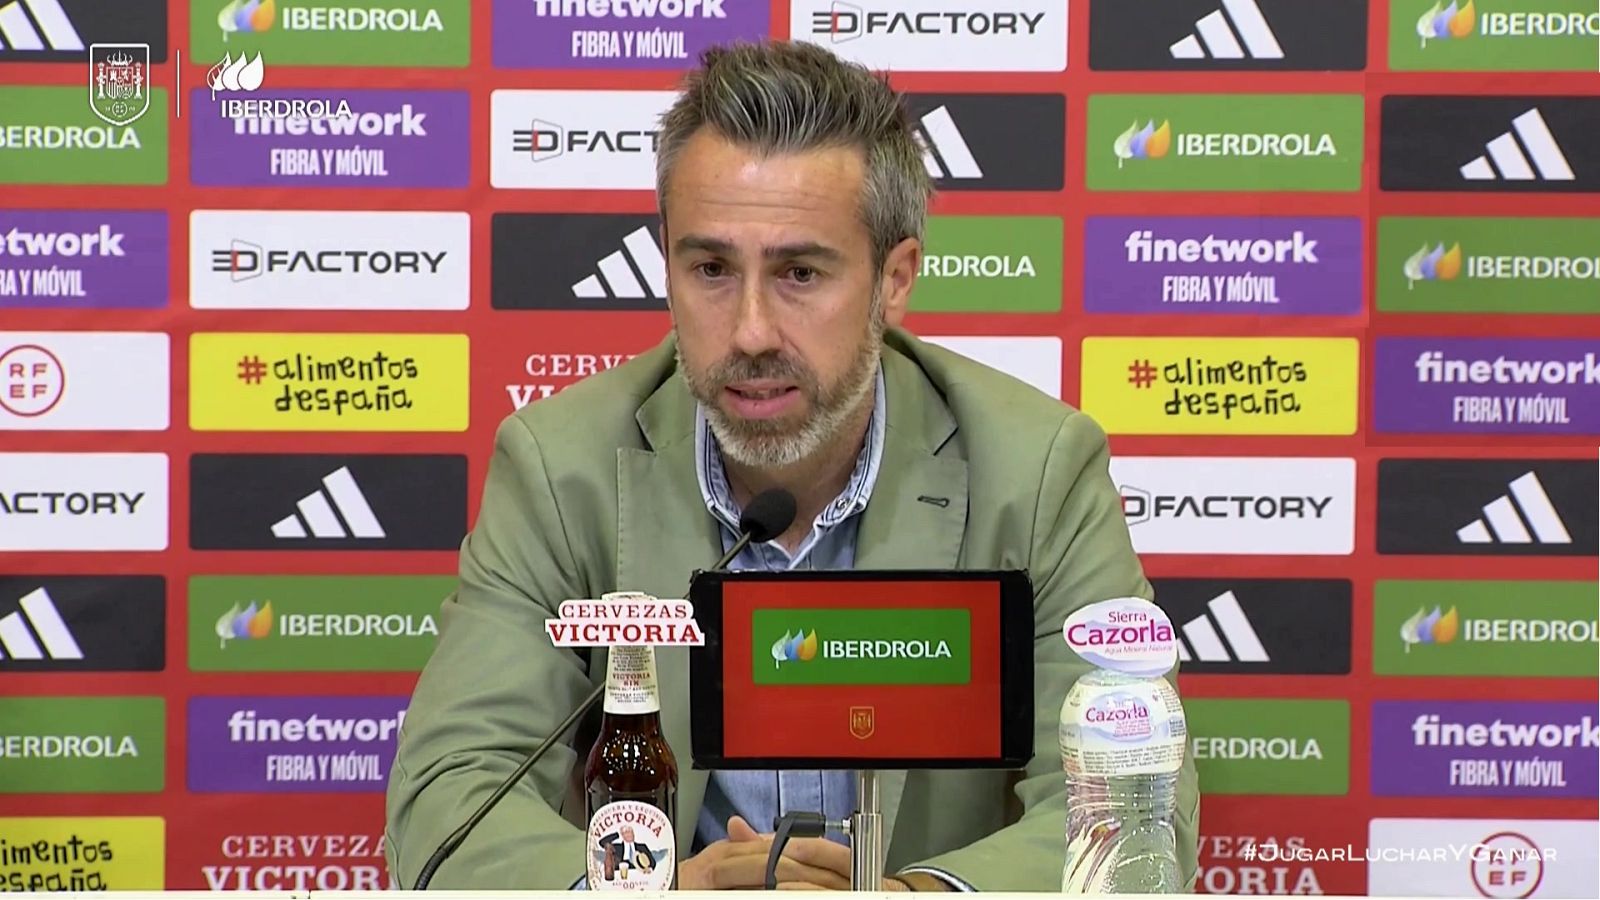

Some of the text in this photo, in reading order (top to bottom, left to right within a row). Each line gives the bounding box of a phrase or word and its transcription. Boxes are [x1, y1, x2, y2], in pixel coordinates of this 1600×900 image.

[282, 7, 443, 32] IBERDROLA
[865, 12, 1046, 36] FACTORY
[572, 27, 688, 59] FIBRA Y MÓVIL
[1177, 132, 1337, 157] IBERDROLA
[270, 145, 388, 176] FIBRA Y MÓVIL
[0, 224, 126, 257] twork
[1125, 230, 1319, 263] finetwork
[267, 250, 447, 274] FACTORY
[917, 255, 1036, 277] RDROLA
[19, 269, 31, 296] Y
[33, 265, 87, 297] MÓVIL
[1162, 271, 1280, 303] FIBRA Y MÓVIL
[525, 354, 639, 376] CERV
[1415, 351, 1600, 384] finetwork
[275, 384, 413, 416] despaña
[1164, 387, 1301, 420] despaña
[1453, 392, 1570, 424] FIBRA Y MÓVIL
[1154, 495, 1333, 519] FACTORY
[280, 613, 438, 637] IBERDROLA
[561, 604, 688, 619] CERVEZAS
[1108, 611, 1147, 623] Sierra
[548, 624, 700, 643] VICTORIA
[1067, 618, 1173, 646] Cazorla
[823, 640, 952, 659] IBERDROLA
[1412, 714, 1599, 747] finetwork
[0, 735, 139, 758] ERDROLA
[266, 750, 384, 781] FIBRA Y MÓVIL
[1450, 756, 1567, 787] FIBRA Y MÓVIL
[594, 811, 664, 838] VICTORIA
